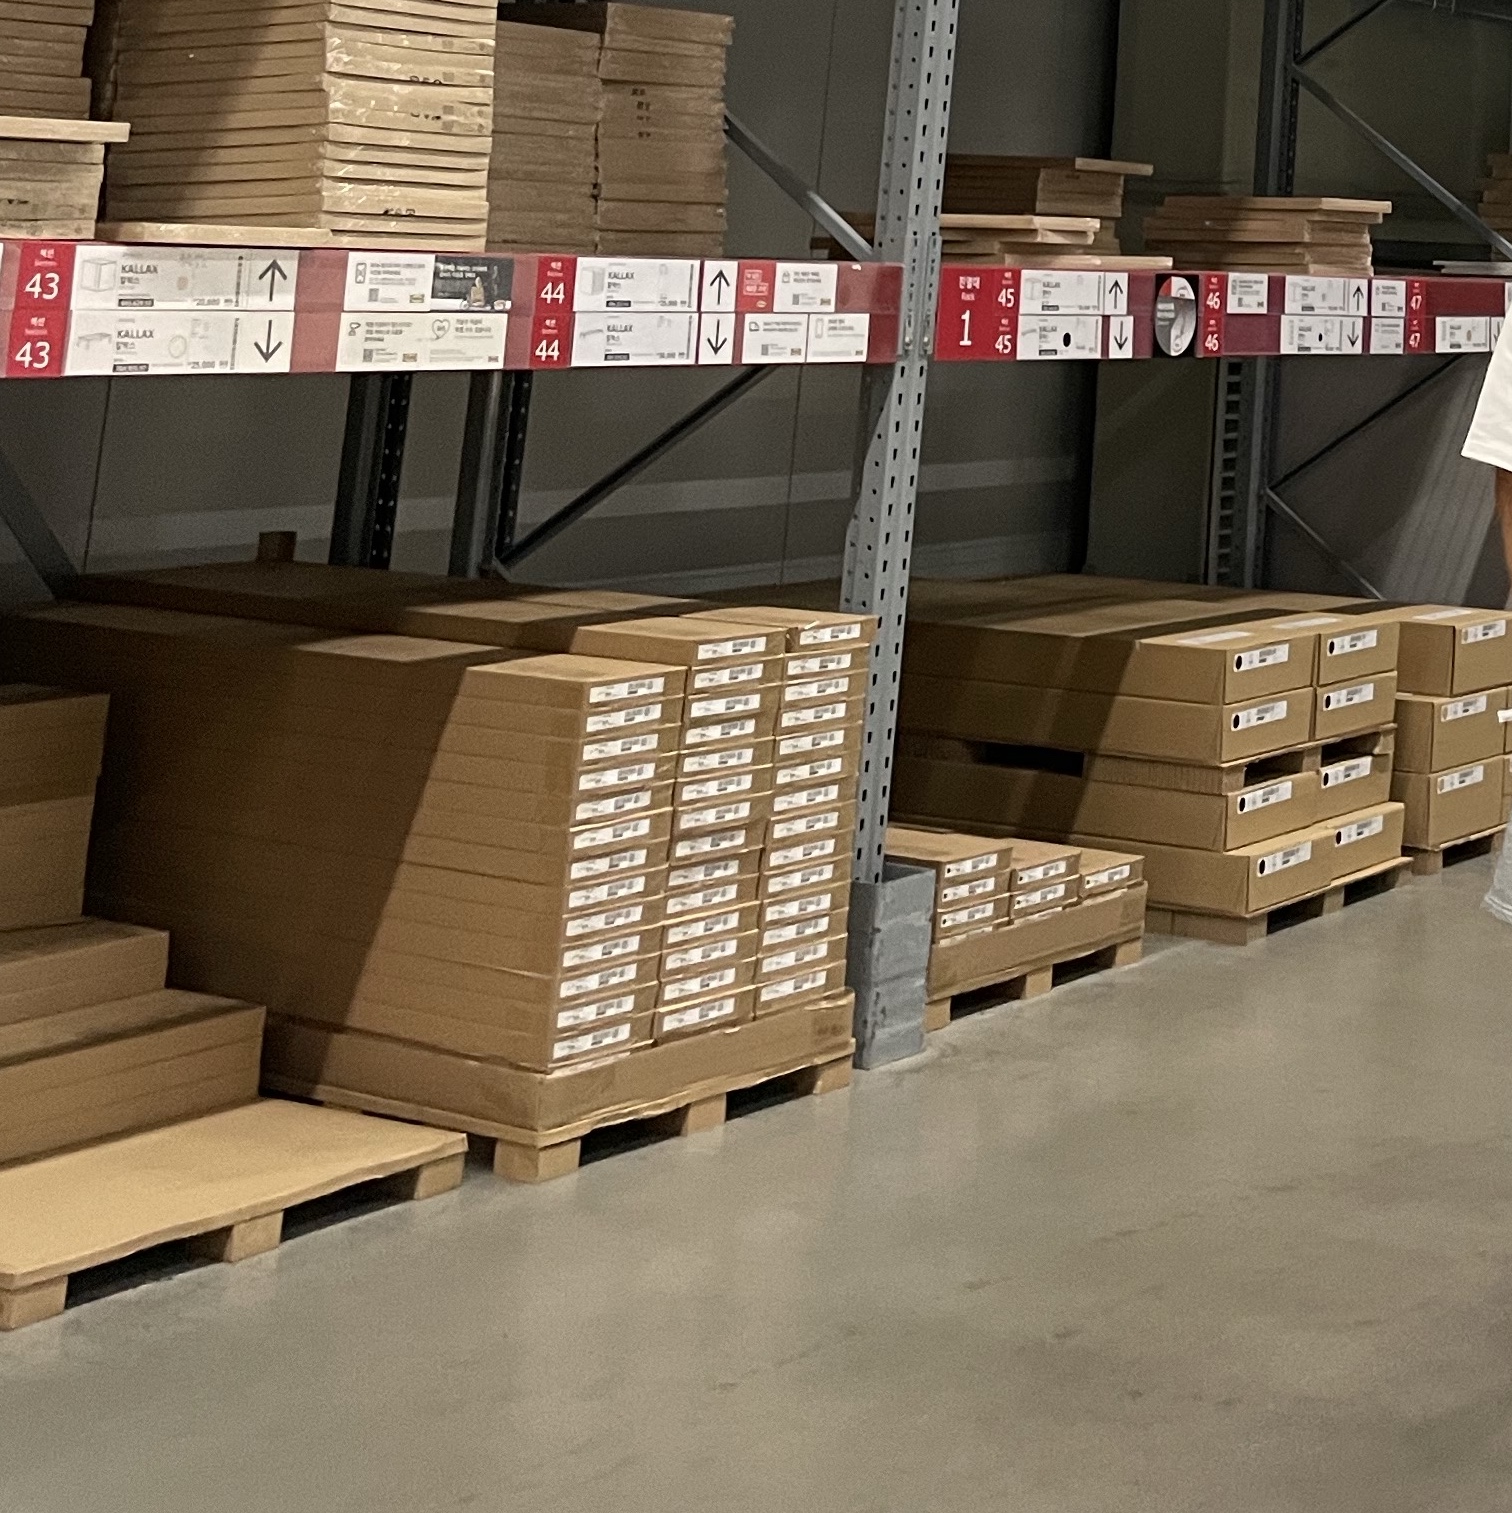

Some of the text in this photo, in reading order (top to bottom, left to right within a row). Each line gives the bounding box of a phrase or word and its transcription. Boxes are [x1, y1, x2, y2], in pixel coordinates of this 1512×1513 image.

[121, 264, 158, 275] KALLAX
[24, 273, 60, 299] 43
[540, 282, 565, 304] 44
[998, 288, 1015, 308] 45
[1206, 292, 1220, 310] 46
[1411, 295, 1422, 310] 47
[117, 330, 154, 339] KALLAX
[959, 309, 972, 346] 1
[995, 334, 1012, 354] 45
[1205, 334, 1219, 351] 46
[1409, 333, 1421, 348] 47
[15, 341, 50, 369] 43
[535, 340, 559, 362] 44
